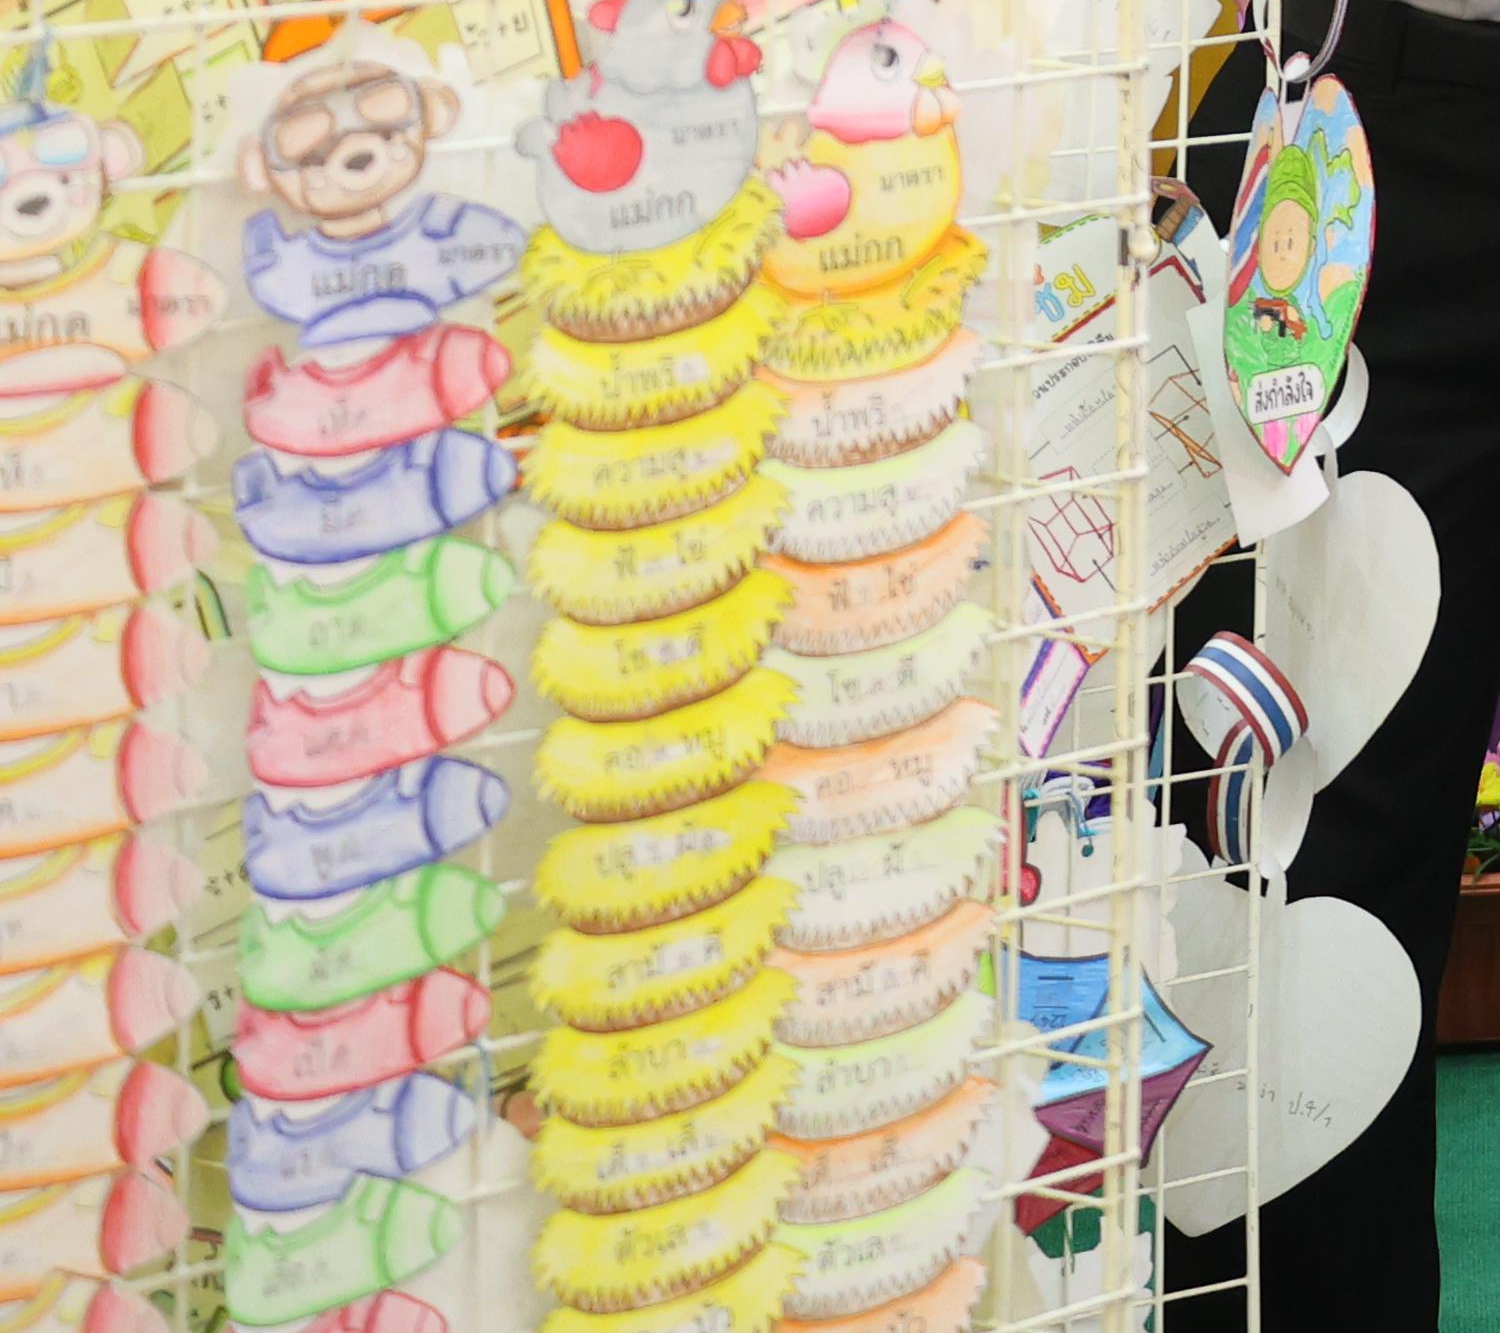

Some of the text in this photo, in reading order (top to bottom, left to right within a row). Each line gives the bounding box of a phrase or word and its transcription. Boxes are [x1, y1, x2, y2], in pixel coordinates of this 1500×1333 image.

[816, 233, 906, 273] แม่กก
[1253, 370, 1316, 415] ส่งกำลังใจ
